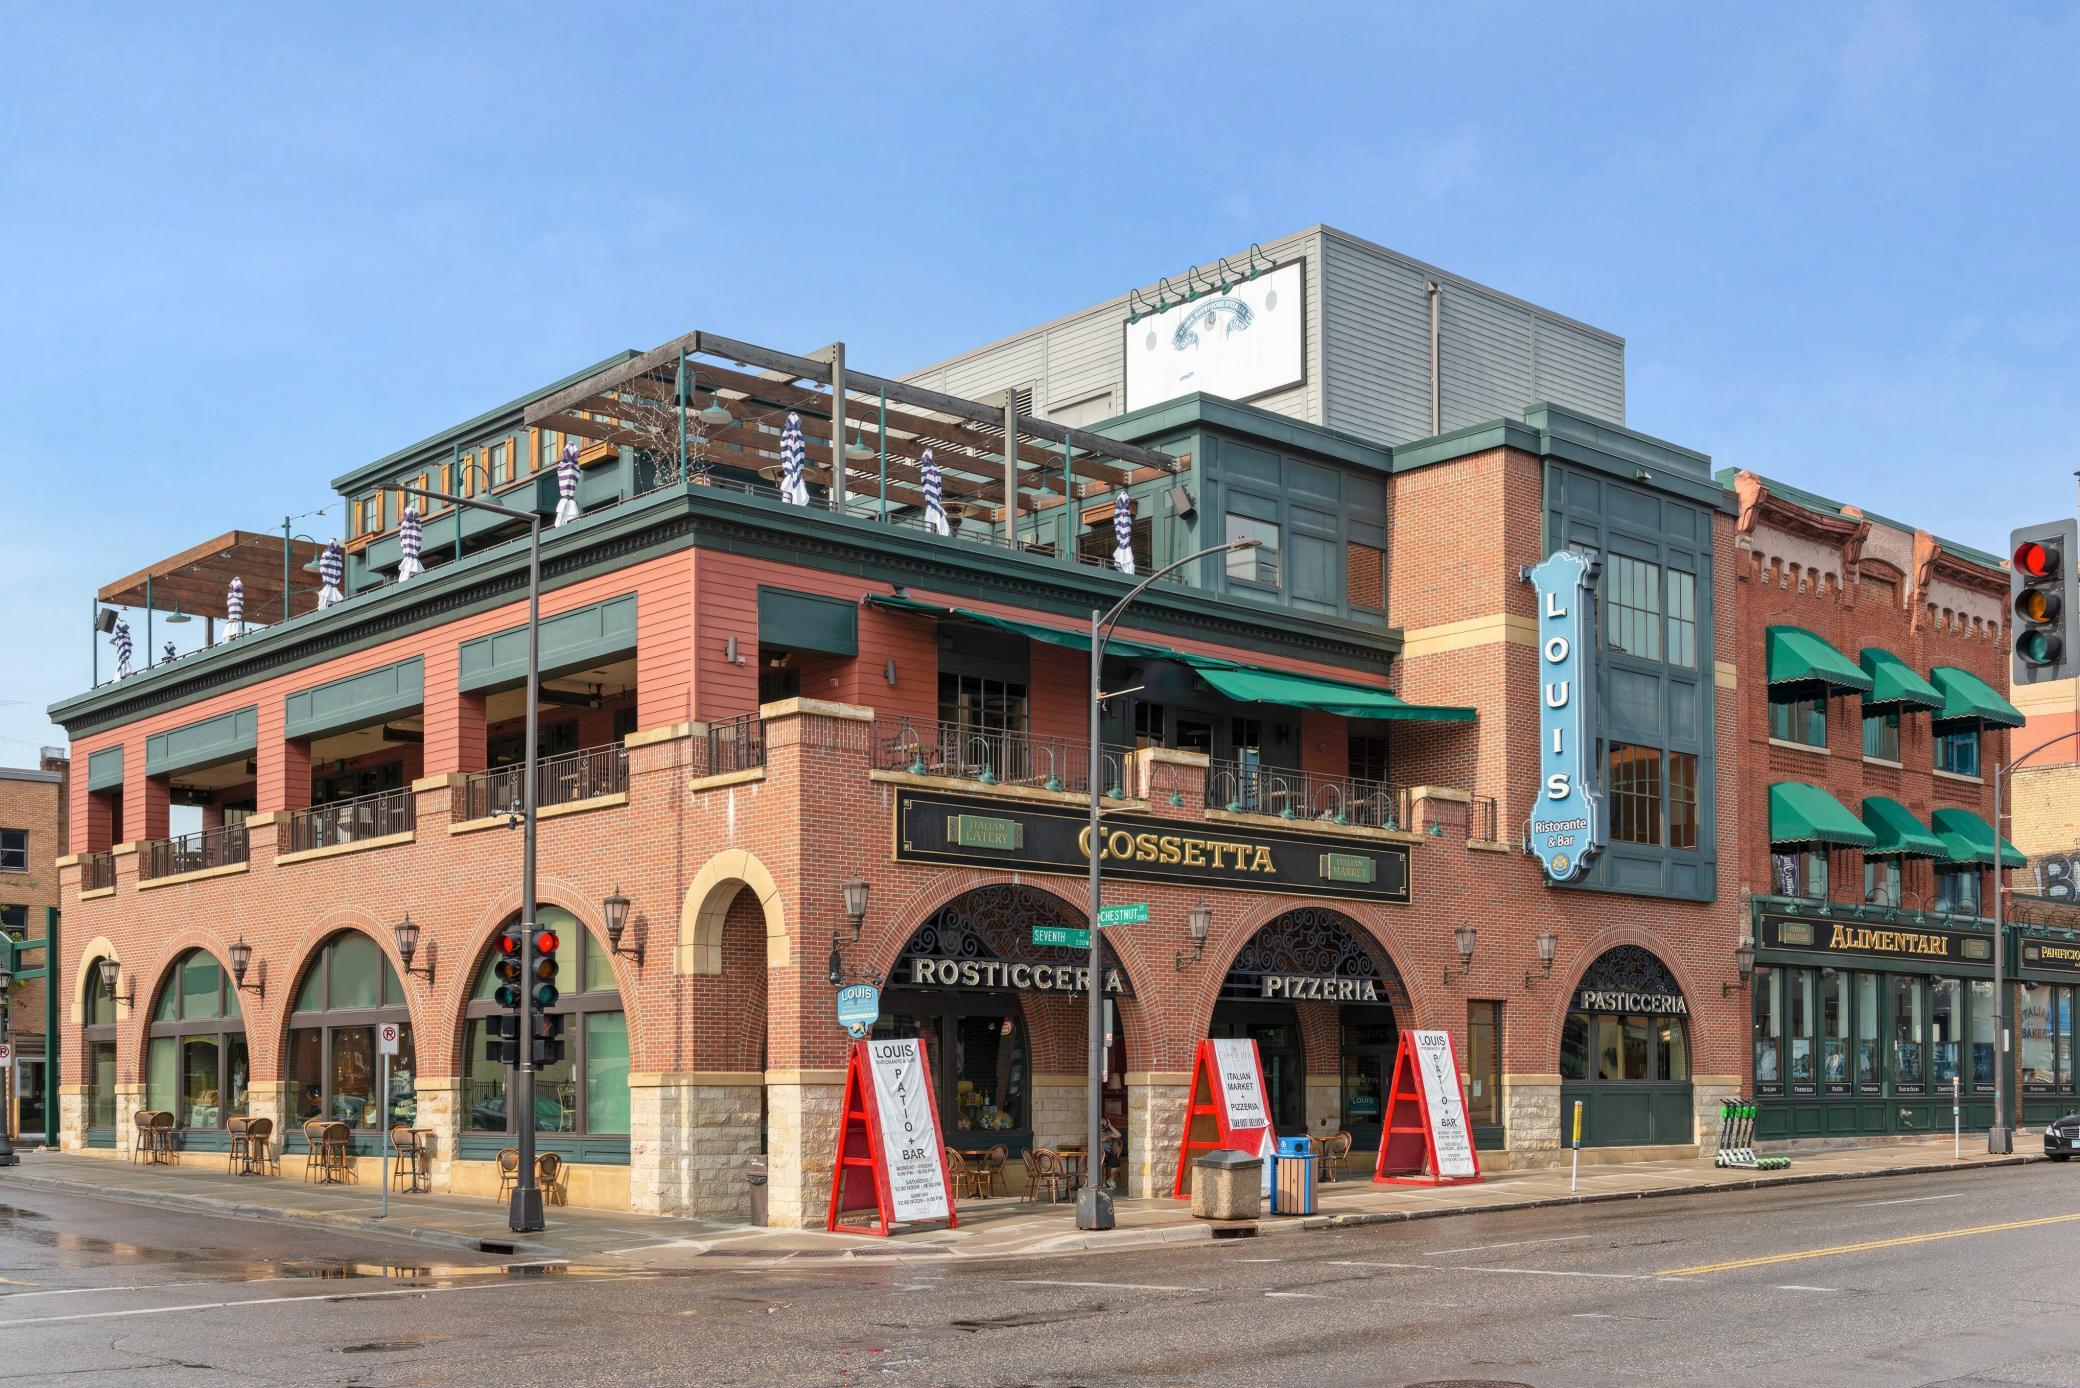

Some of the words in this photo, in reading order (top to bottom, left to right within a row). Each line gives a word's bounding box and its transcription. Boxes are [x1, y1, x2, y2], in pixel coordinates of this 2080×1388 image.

[1544, 592, 1571, 799] LOUIS
[969, 819, 1006, 831] ITALIAN
[1535, 818, 1587, 834] Ristorante
[966, 831, 1008, 844] EATERY
[1548, 835, 1556, 847] &
[1557, 835, 1575, 847] Bar
[1078, 824, 1277, 874] COSSETTA
[1100, 908, 1138, 922] CHESTNUT
[1034, 929, 1066, 943] SEVENTH
[1829, 924, 1949, 956] ALIMENTARI
[911, 958, 1124, 993] ROSTICCERA
[841, 987, 873, 1002] LOUIS
[1262, 975, 1378, 1001] PIZZERIA
[1581, 990, 1687, 1014] PASTICCERIA
[1419, 1035, 1446, 1046] LOUIS
[875, 1044, 914, 1059] LOUIS
[1227, 1073, 1251, 1081] ITALIAN
[1433, 1054, 1448, 1105] PATIO
[1227, 1083, 1254, 1091] MARKET
[895, 1068, 913, 1132] PATIO
[1231, 1103, 1260, 1111] PIZZERIA
[1441, 1118, 1458, 1127] BAR
[902, 1148, 926, 1160] BAR
